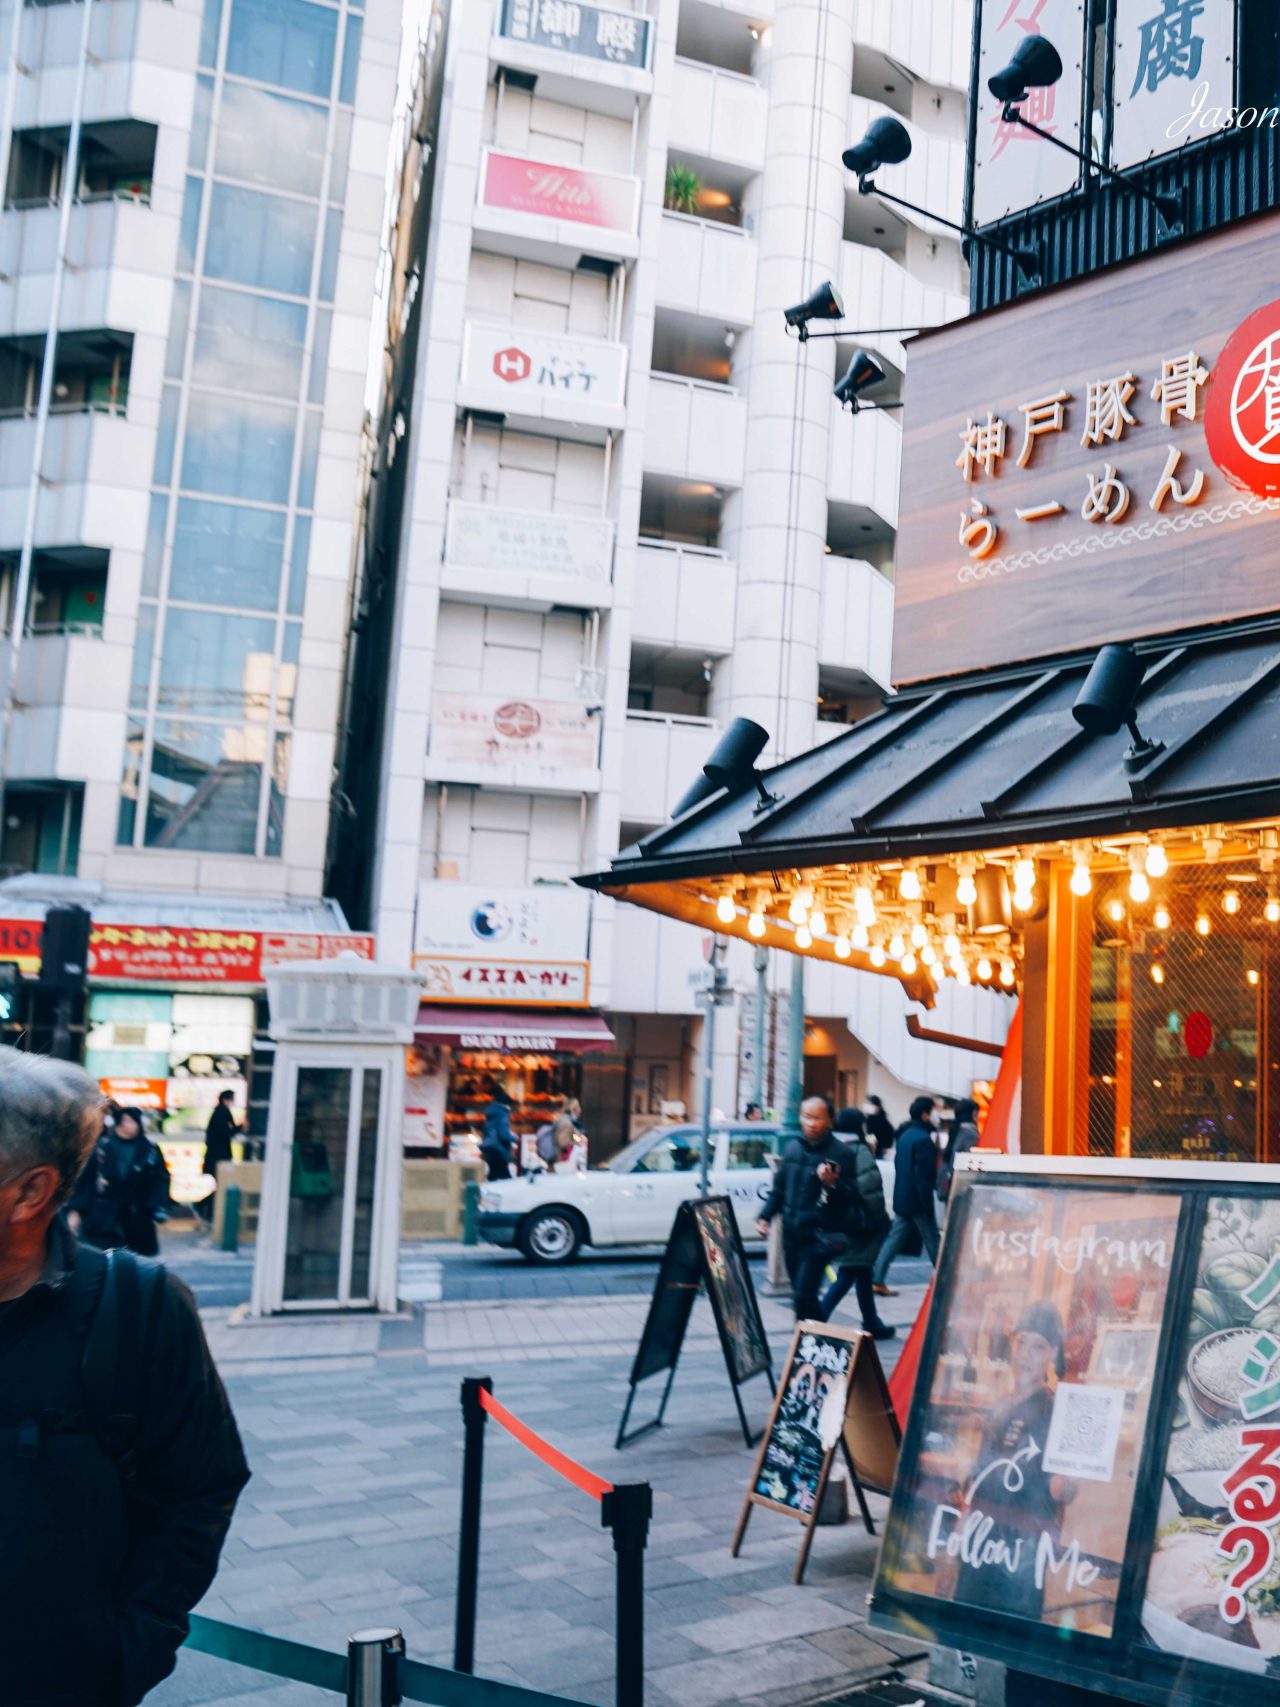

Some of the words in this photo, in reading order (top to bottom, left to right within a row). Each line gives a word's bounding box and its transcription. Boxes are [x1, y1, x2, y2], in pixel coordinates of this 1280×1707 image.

[956, 350, 1210, 481] 神戸豚骨
[958, 444, 1205, 558] らーめん
[506, 1036, 557, 1050] BAKERY
[972, 1218, 1168, 1275] Instagram
[927, 1504, 1024, 1574] Follow
[1035, 1532, 1101, 1592] Me
